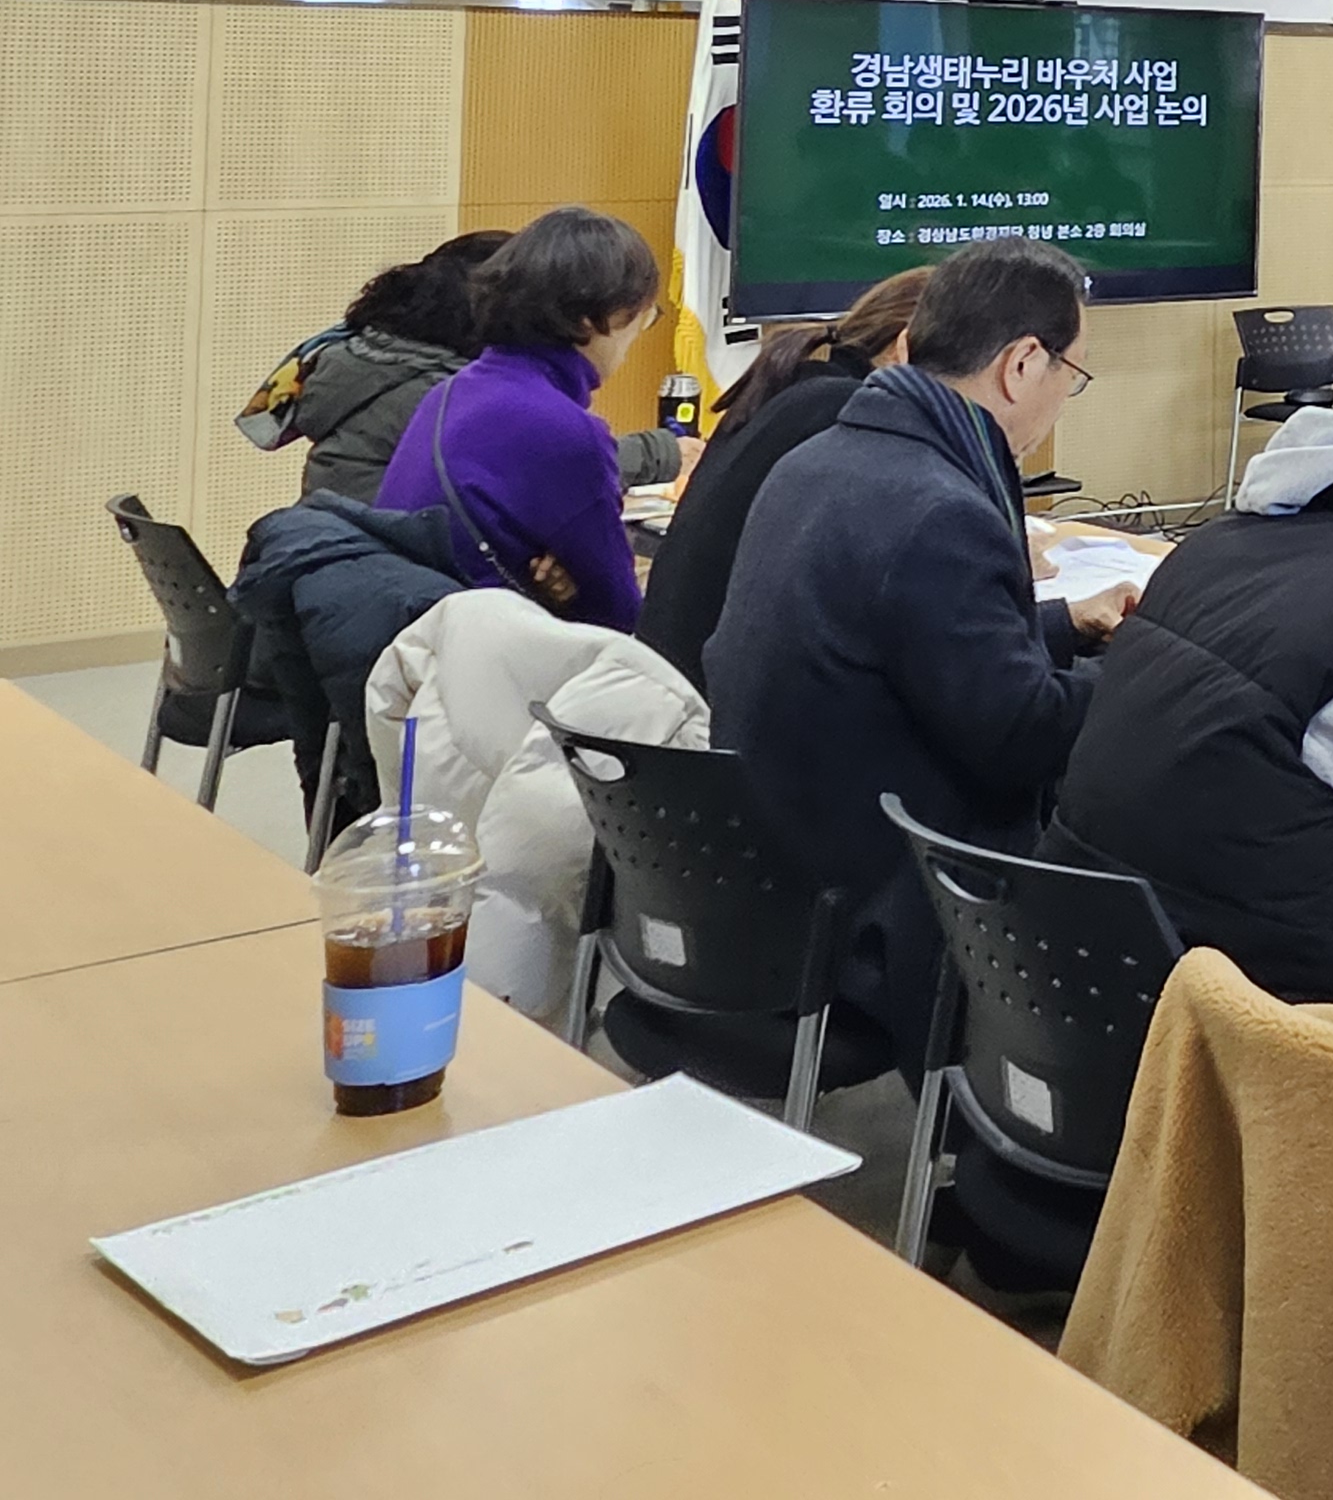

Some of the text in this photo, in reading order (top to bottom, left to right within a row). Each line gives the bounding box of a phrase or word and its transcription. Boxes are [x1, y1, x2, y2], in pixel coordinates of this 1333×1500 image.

[851, 53, 1178, 92] 경남생태누리 바우처 사업
[810, 88, 1208, 126] 환류 회의 및 2026년 사업 논의
[878, 193, 906, 209] 일시
[877, 229, 906, 245] 장소
